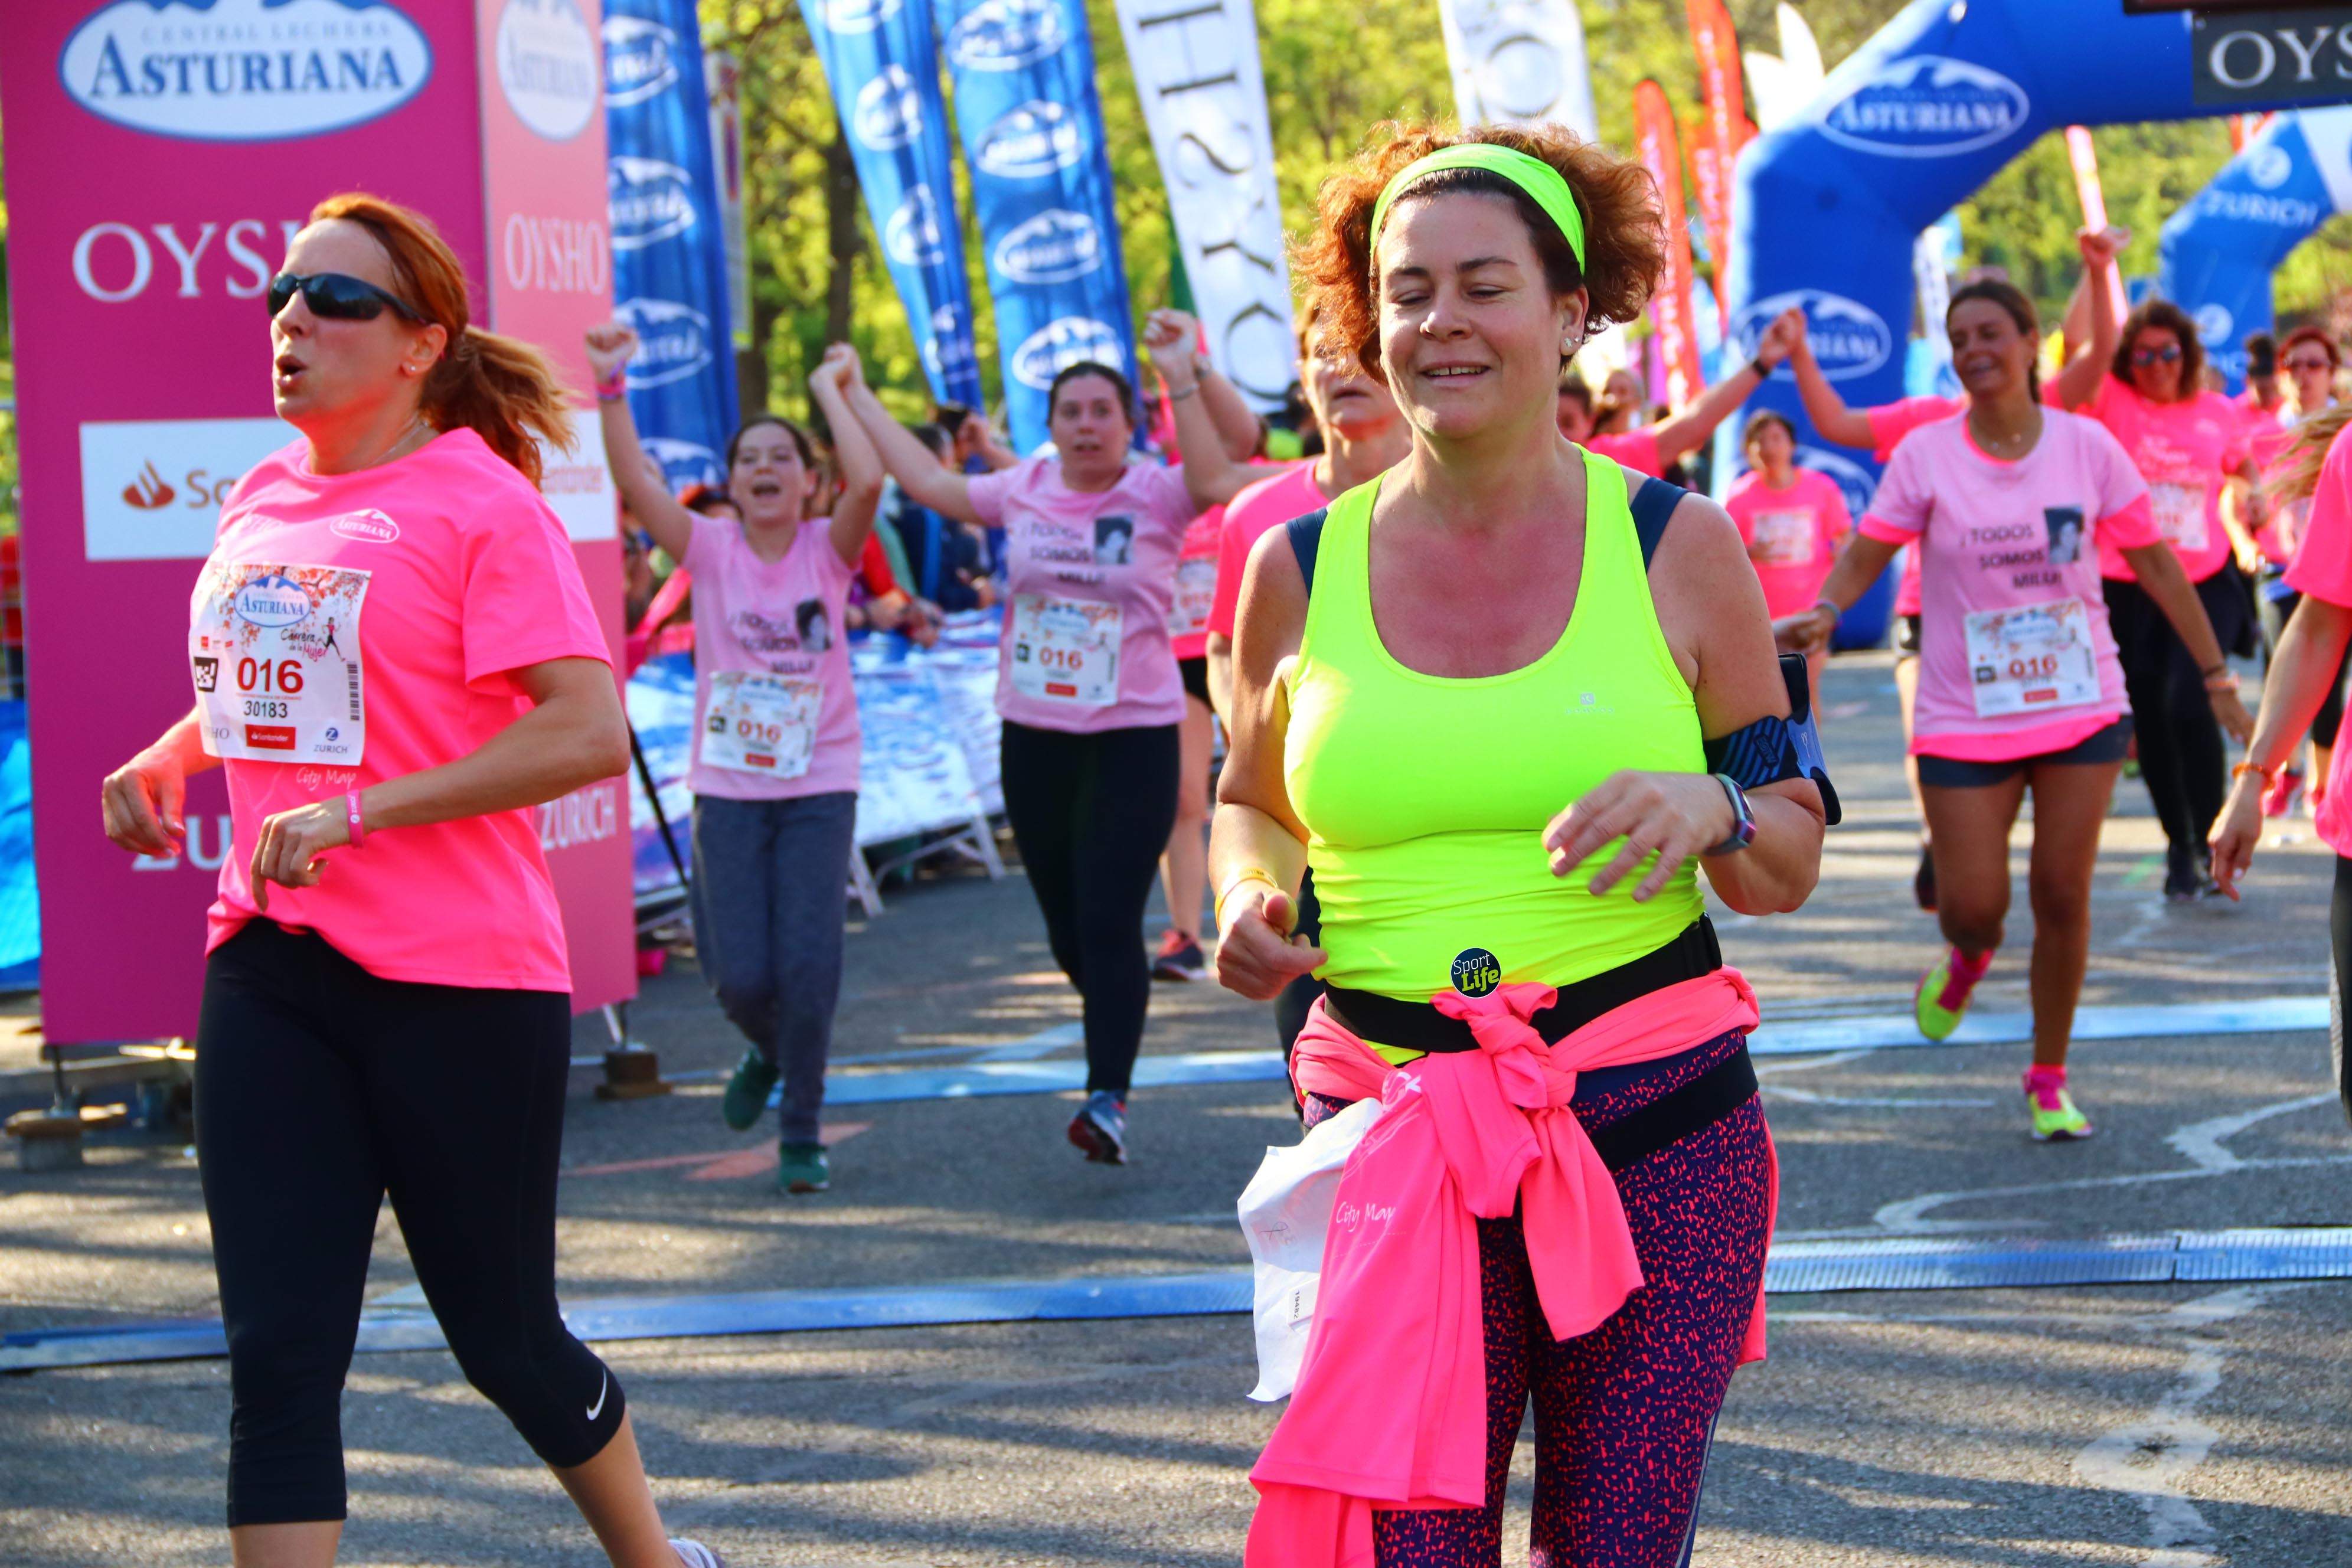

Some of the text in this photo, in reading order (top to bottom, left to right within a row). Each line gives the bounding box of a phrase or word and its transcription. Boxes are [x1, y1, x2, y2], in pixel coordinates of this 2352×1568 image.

[141, 21, 391, 43] CENTRAL LECHERA
[89, 31, 404, 99] ASTURIANA
[1829, 92, 2011, 132] ASTURIANA
[72, 220, 303, 302] OYS
[505, 213, 608, 295] OYSHO
[1979, 548, 2044, 570] SOMOS
[239, 592, 304, 615] ASTURIANA
[280, 628, 316, 642] Carrera
[1040, 645, 1084, 671] 016
[2008, 654, 2058, 678] 016
[237, 657, 303, 694] 016
[243, 700, 288, 718] 30183
[257, 733, 289, 743] Santander
[737, 718, 782, 744] 016
[313, 744, 348, 754] ZURICH
[296, 766, 322, 792] City
[537, 785, 617, 851] ZURICH
[1453, 952, 1491, 975] Sport
[1461, 966, 1500, 992] Life
[1335, 1201, 1360, 1233] City
